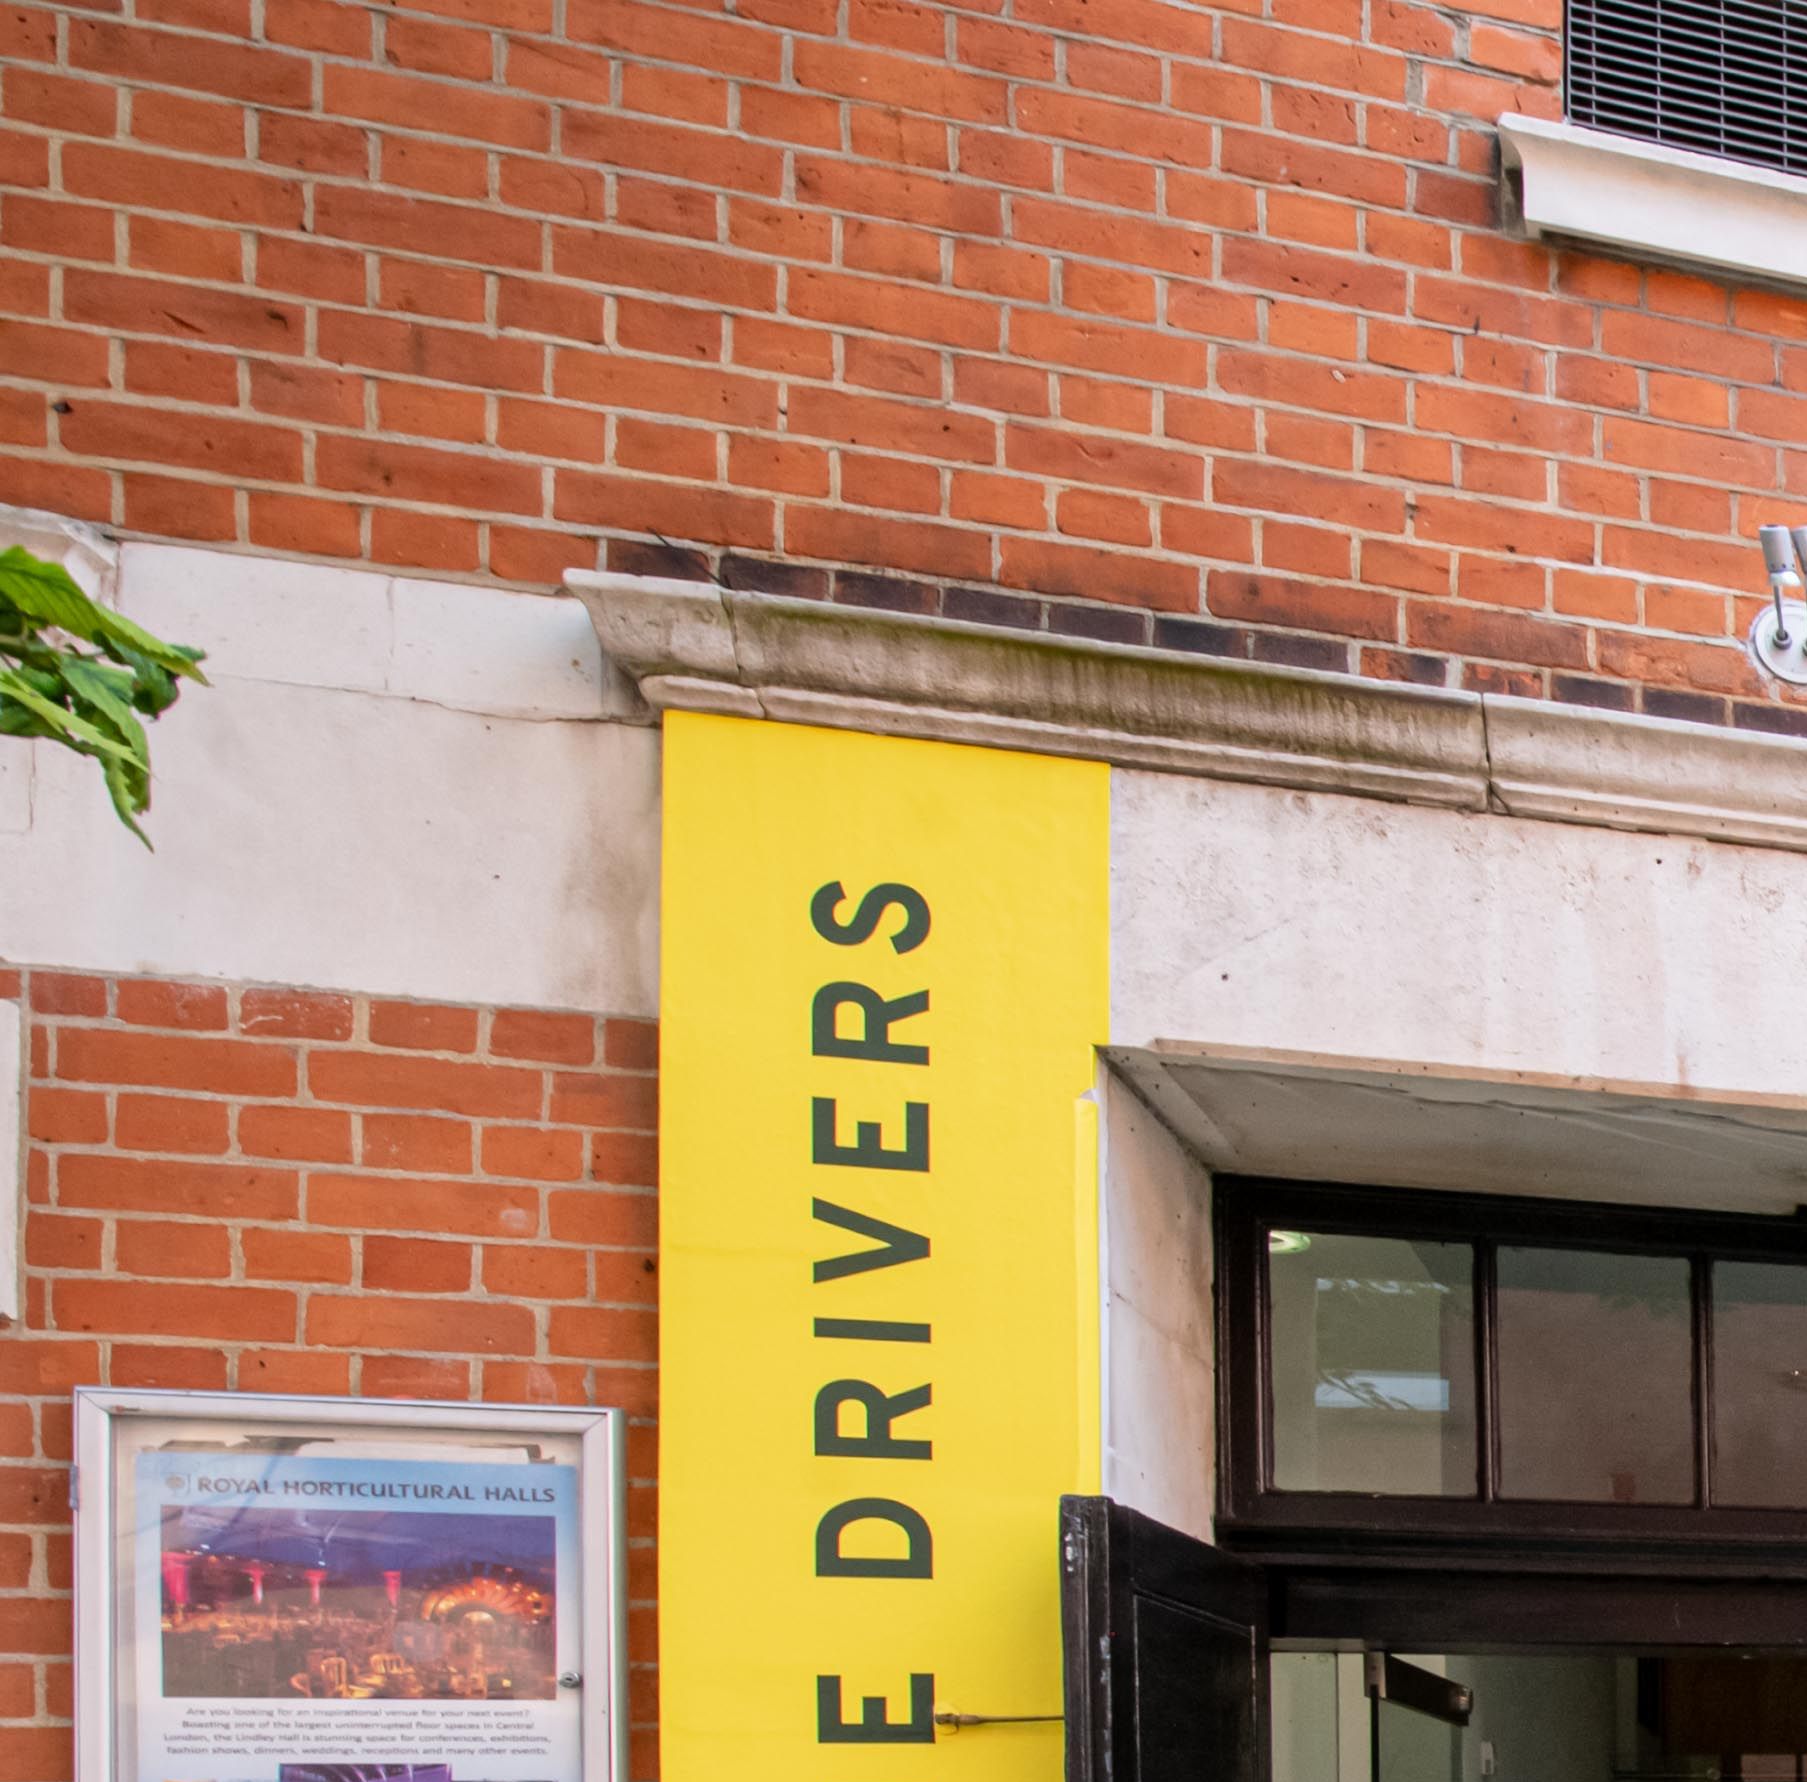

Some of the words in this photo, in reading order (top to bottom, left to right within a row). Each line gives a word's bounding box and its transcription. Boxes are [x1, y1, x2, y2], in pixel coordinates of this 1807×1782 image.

[811, 880, 933, 1580] DRIVERS
[198, 1476, 275, 1495] ROYAL
[283, 1480, 476, 1501] HORTICULTURAL
[485, 1486, 556, 1503] HALLS
[209, 1709, 231, 1718] you
[234, 1708, 274, 1718] looking
[277, 1708, 292, 1716] for
[422, 1709, 437, 1717] for
[440, 1710, 464, 1719] your
[259, 1720, 271, 1729] of
[273, 1721, 291, 1729] the
[294, 1721, 332, 1731] largest
[416, 1721, 441, 1729] floor
[445, 1722, 480, 1731] spaces
[214, 1734, 232, 1742] the
[314, 1734, 362, 1744] stunning
[366, 1735, 397, 1744] space
[400, 1734, 415, 1742] for
[167, 1746, 209, 1755] fashion
[361, 1747, 419, 1757] receptions
[422, 1747, 442, 1755] and
[445, 1748, 475, 1757] many
[478, 1747, 507, 1755] other
